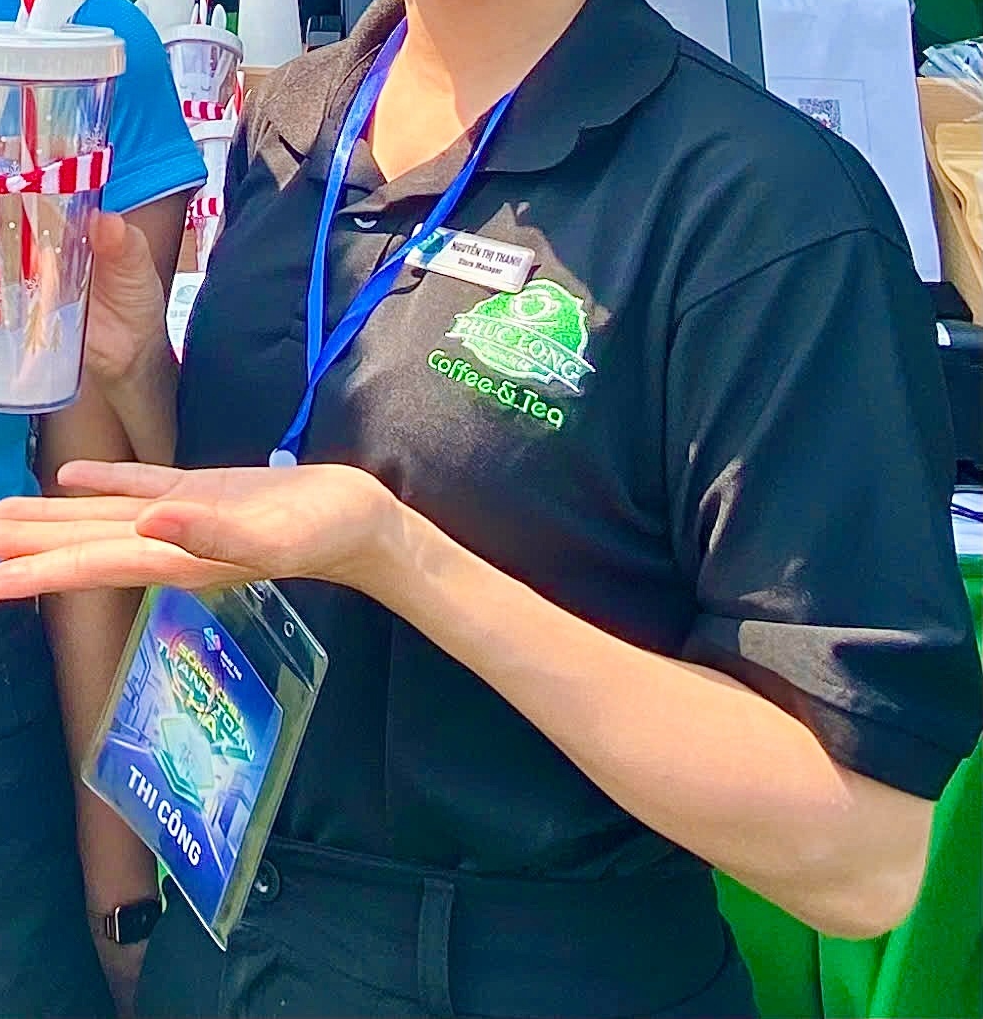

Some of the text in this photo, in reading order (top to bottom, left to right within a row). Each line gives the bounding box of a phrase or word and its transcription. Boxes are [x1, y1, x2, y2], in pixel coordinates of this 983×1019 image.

[475, 262, 503, 274] Manager
[517, 332, 581, 380] LONG
[428, 349, 493, 393] Coffee
[496, 378, 518, 406] &
[519, 389, 564, 429] Tea
[128, 765, 202, 866] THI CÔNG
